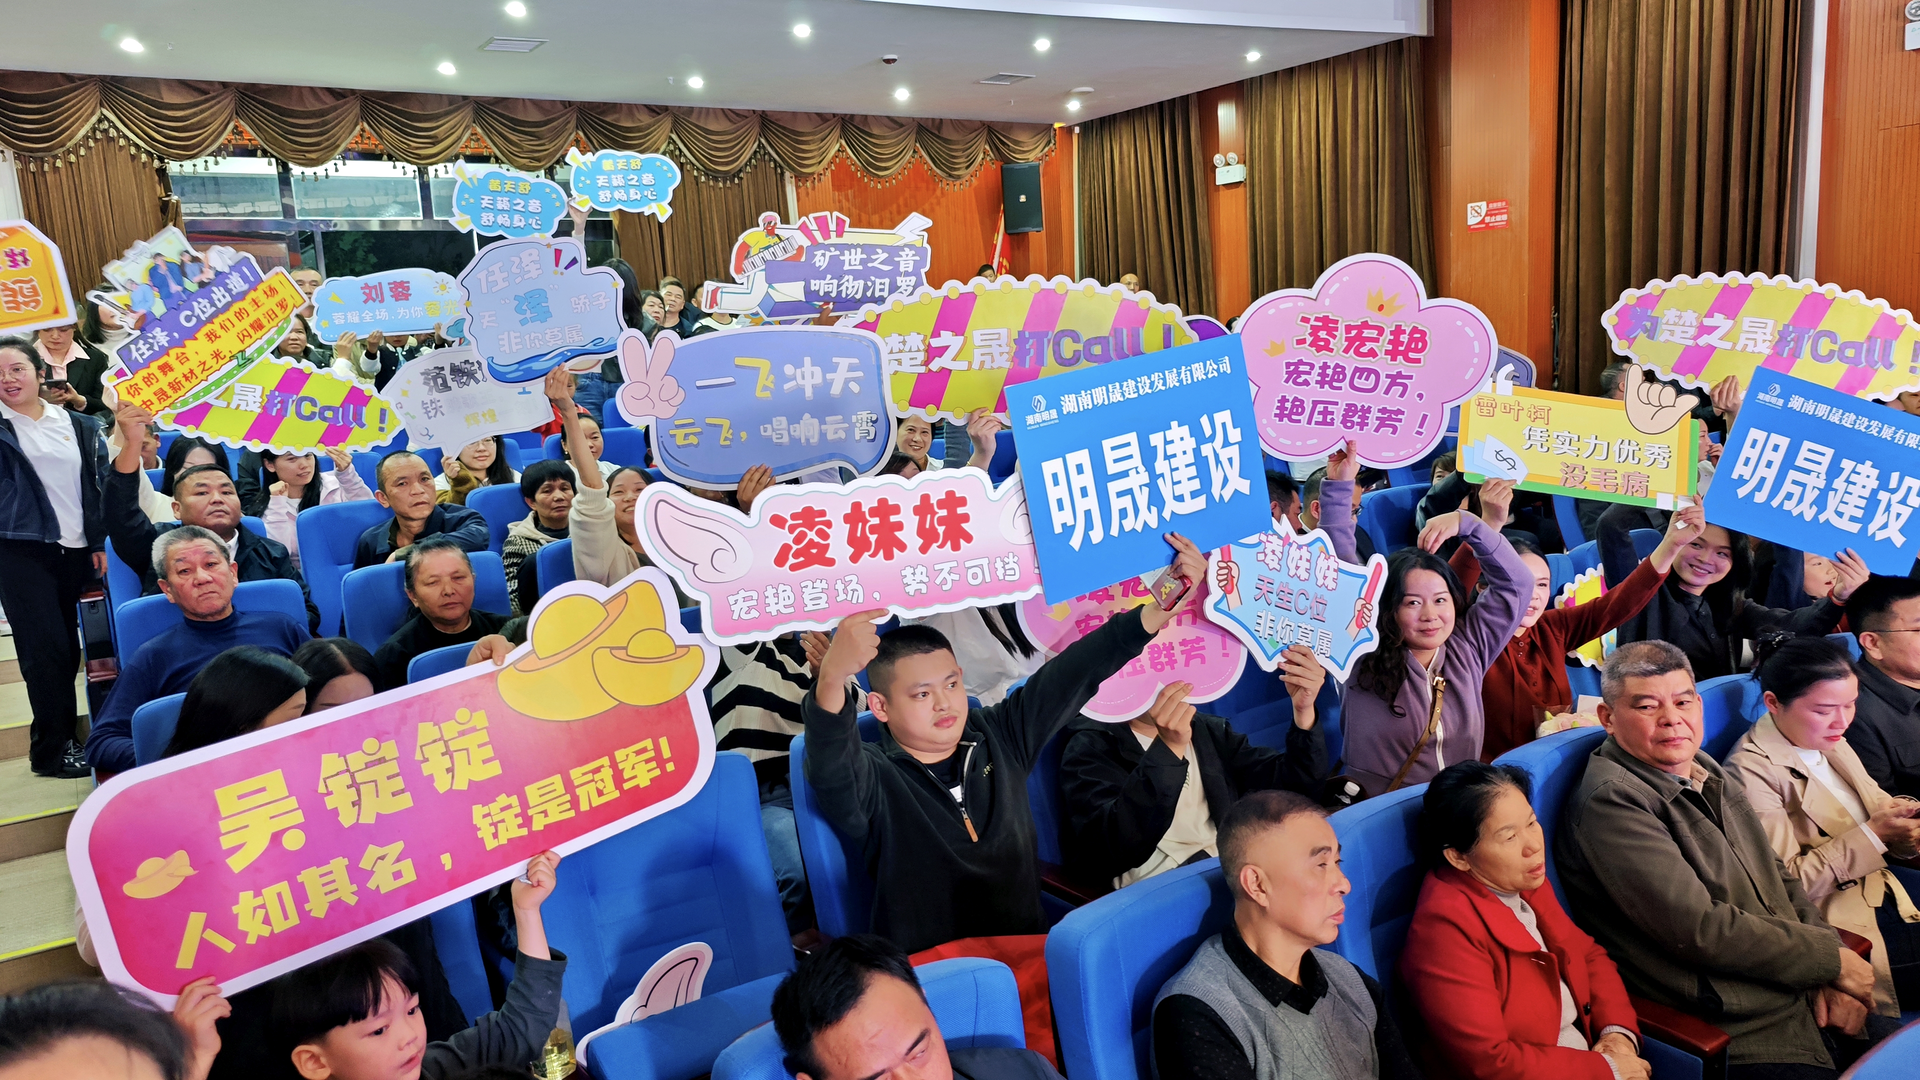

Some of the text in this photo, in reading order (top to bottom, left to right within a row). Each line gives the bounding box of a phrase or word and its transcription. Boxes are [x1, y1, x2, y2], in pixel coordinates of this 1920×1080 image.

[598, 188, 657, 203] 舒畅身心
[480, 212, 542, 229] 舒畅身心
[475, 248, 543, 294] 任泽
[811, 247, 920, 272] 矿世之音
[360, 280, 412, 304] 刘蓉
[810, 274, 917, 299] 响彻汨罗
[498, 323, 585, 354] 非你莫属
[1295, 314, 1429, 364] 凌宏艳
[696, 356, 864, 400] 一飞冲天
[1060, 356, 1231, 415] 湖南明晟建设发展有限公司
[1475, 395, 1552, 425] 雷叶柯
[1787, 394, 1920, 450] 湖南明晟建设发展有限
[1522, 425, 1672, 469] 凭实力优秀
[1040, 409, 1252, 552] 明晟建设
[1559, 462, 1649, 498] 没毛病
[1731, 426, 1920, 549] 明晟建设
[769, 489, 974, 573] 凌妹妹
[1256, 532, 1339, 591] 凌妹妹
[1254, 574, 1328, 623] 天生C位
[1254, 610, 1333, 658] 非你莫属
[214, 707, 503, 874] 吴锭锭
